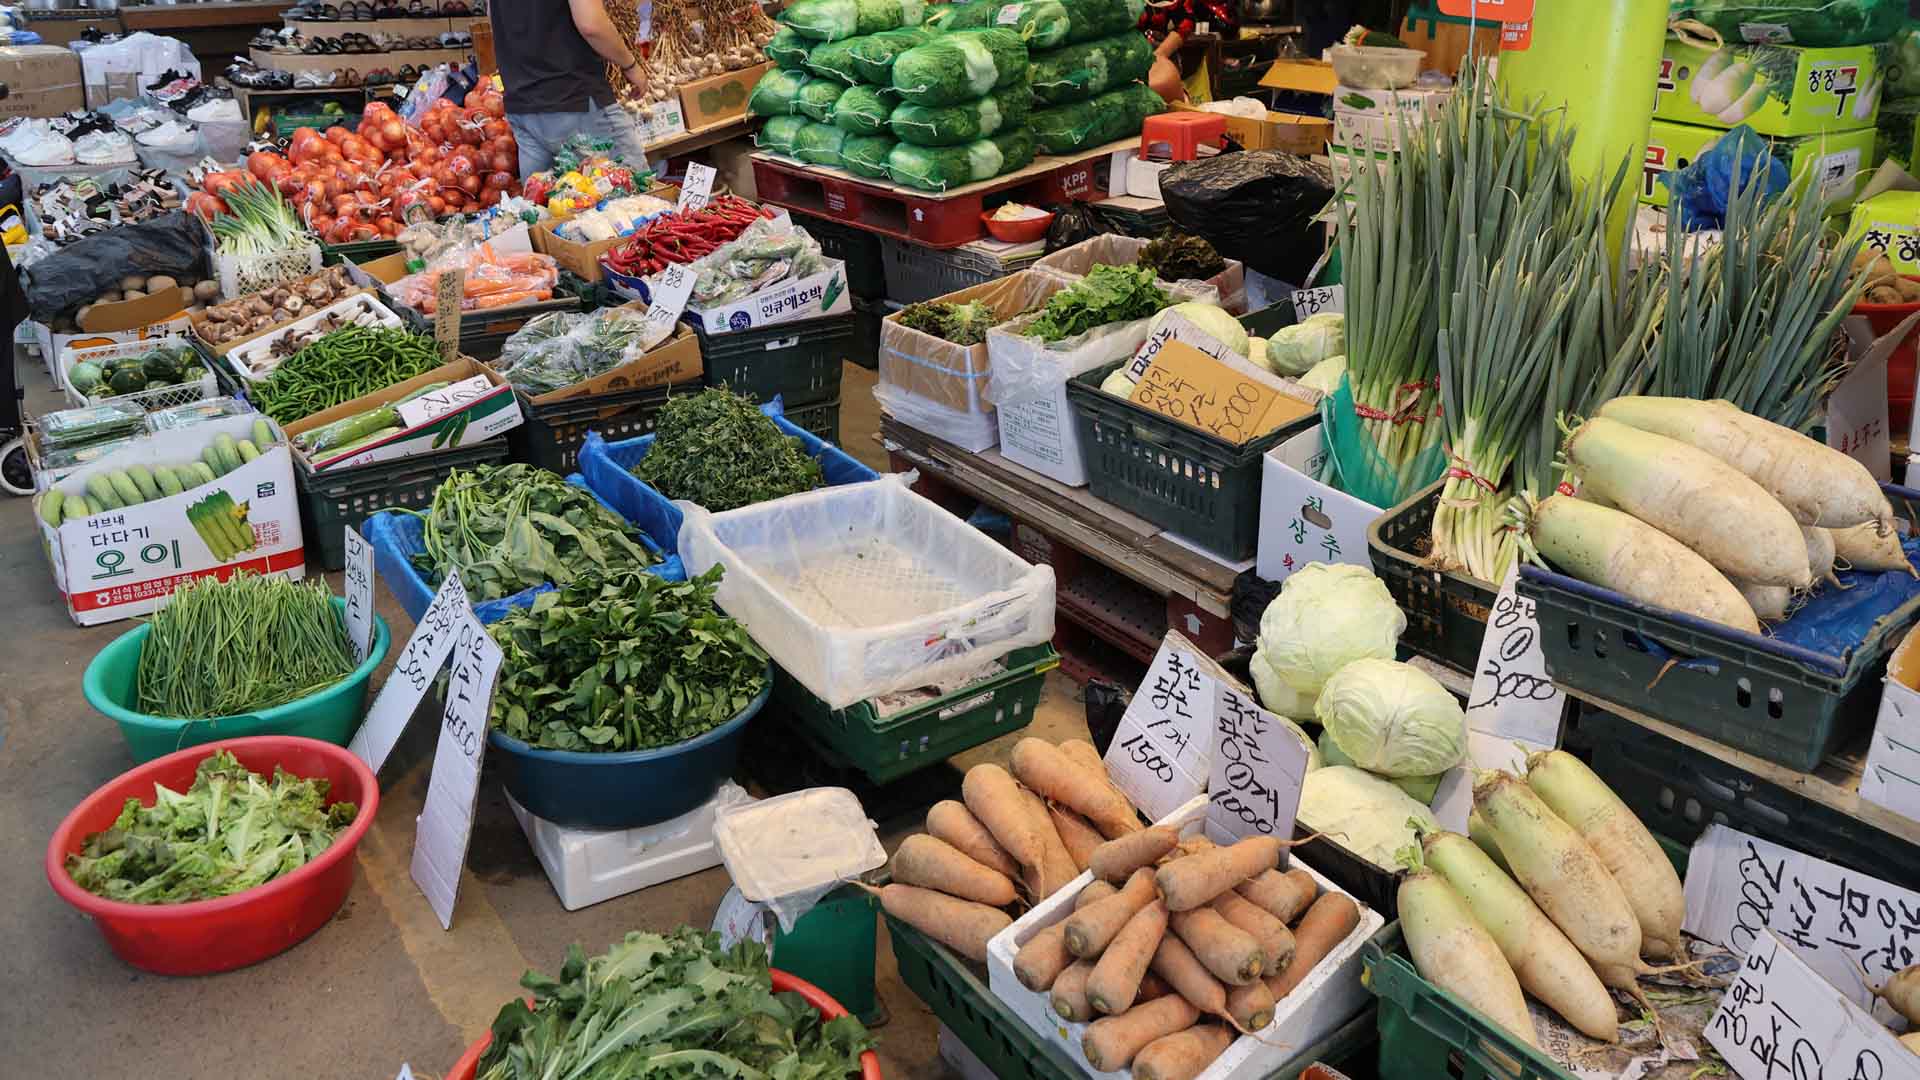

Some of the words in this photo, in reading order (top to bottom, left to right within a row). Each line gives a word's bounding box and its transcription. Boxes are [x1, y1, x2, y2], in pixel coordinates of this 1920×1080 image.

[1063, 170, 1088, 190] KPP
[761, 285, 823, 317] 인큐애호박
[1296, 288, 1337, 318] 무공해
[1139, 365, 1170, 404] 애기
[87, 514, 126, 529] 너브내
[90, 526, 150, 548] 다다기
[91, 539, 182, 581] 오이
[1167, 652, 1201, 691] 국산
[1151, 675, 1193, 719] 당근
[1223, 690, 1270, 735] 국산
[1147, 719, 1191, 759] 1개
[1219, 716, 1270, 764] 당근
[1714, 942, 1779, 1046] 강원도
